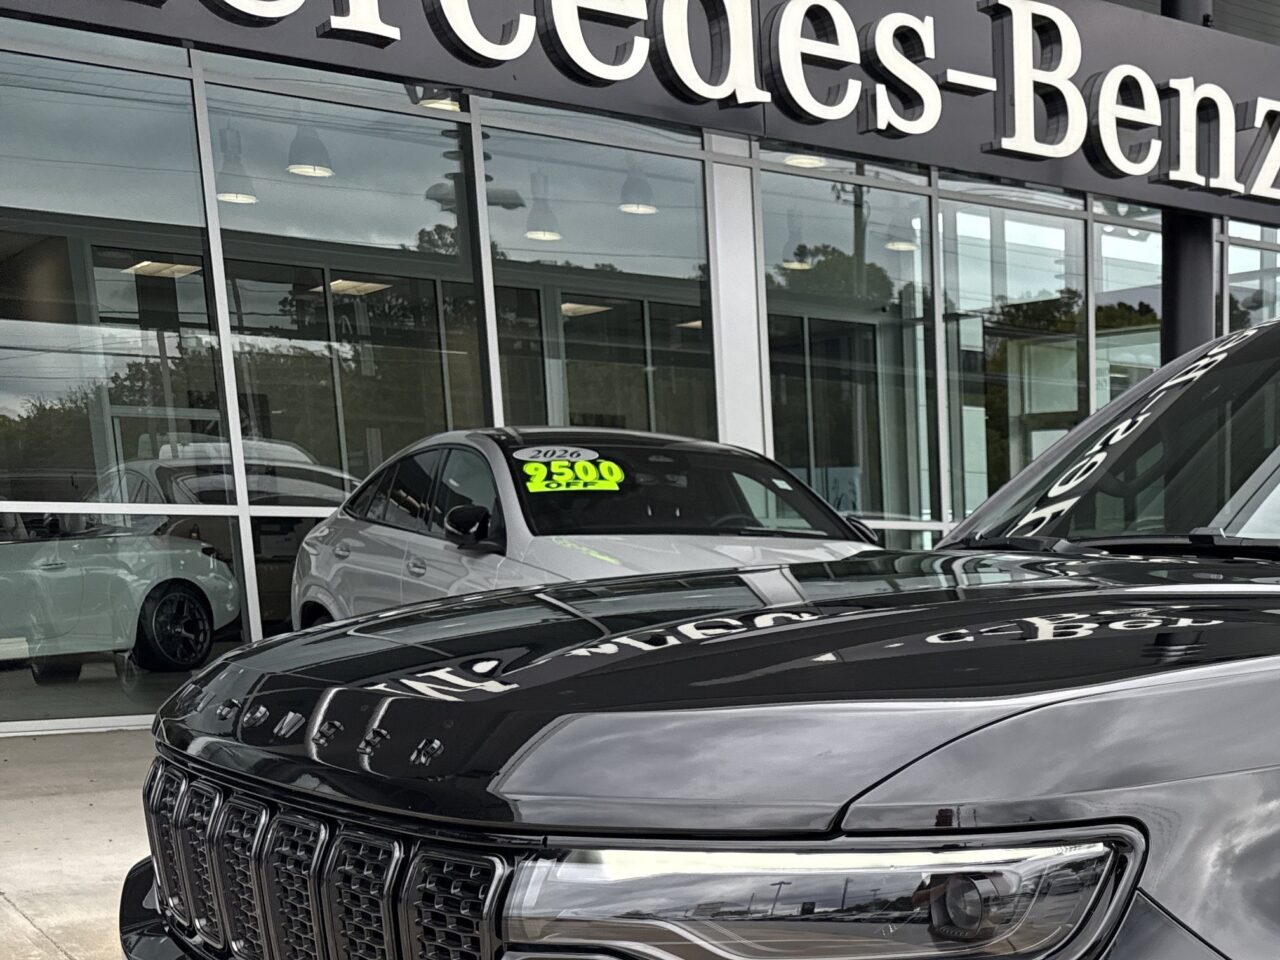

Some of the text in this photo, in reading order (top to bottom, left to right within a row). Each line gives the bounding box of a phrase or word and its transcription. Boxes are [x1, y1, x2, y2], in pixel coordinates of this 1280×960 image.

[529, 449, 583, 459] 2026
[523, 460, 625, 484] 9500
[544, 481, 598, 490] OFF
